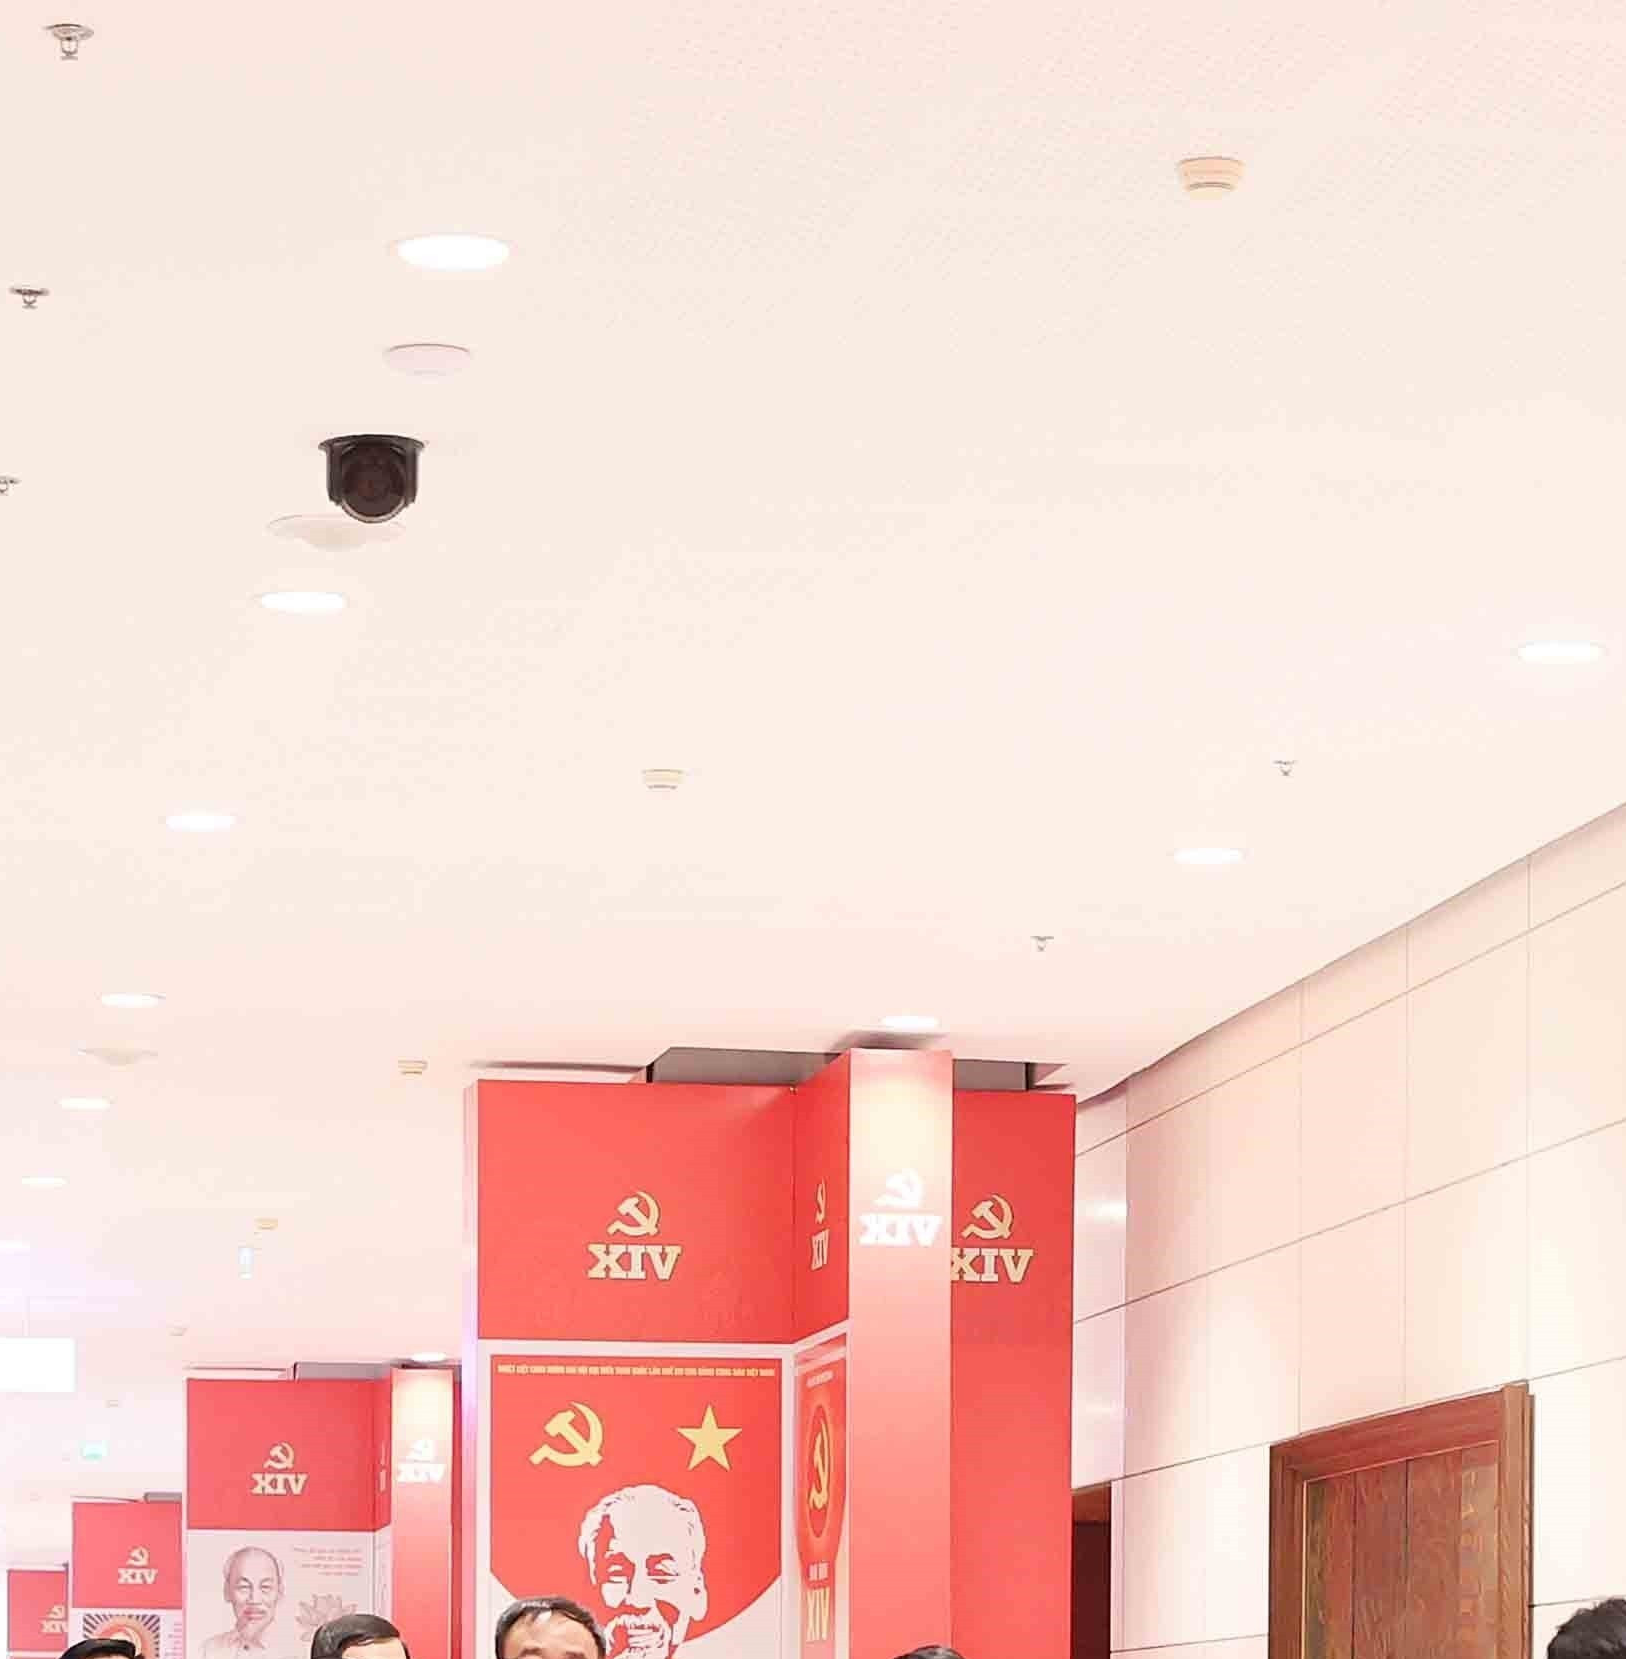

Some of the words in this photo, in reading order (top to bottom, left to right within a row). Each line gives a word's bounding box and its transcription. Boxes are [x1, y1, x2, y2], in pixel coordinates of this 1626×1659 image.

[858, 1213, 944, 1248] XIV
[586, 1242, 683, 1281] XIV
[951, 1246, 1035, 1284] XIV
[250, 1472, 309, 1496] XIV
[117, 1568, 159, 1585] XIV
